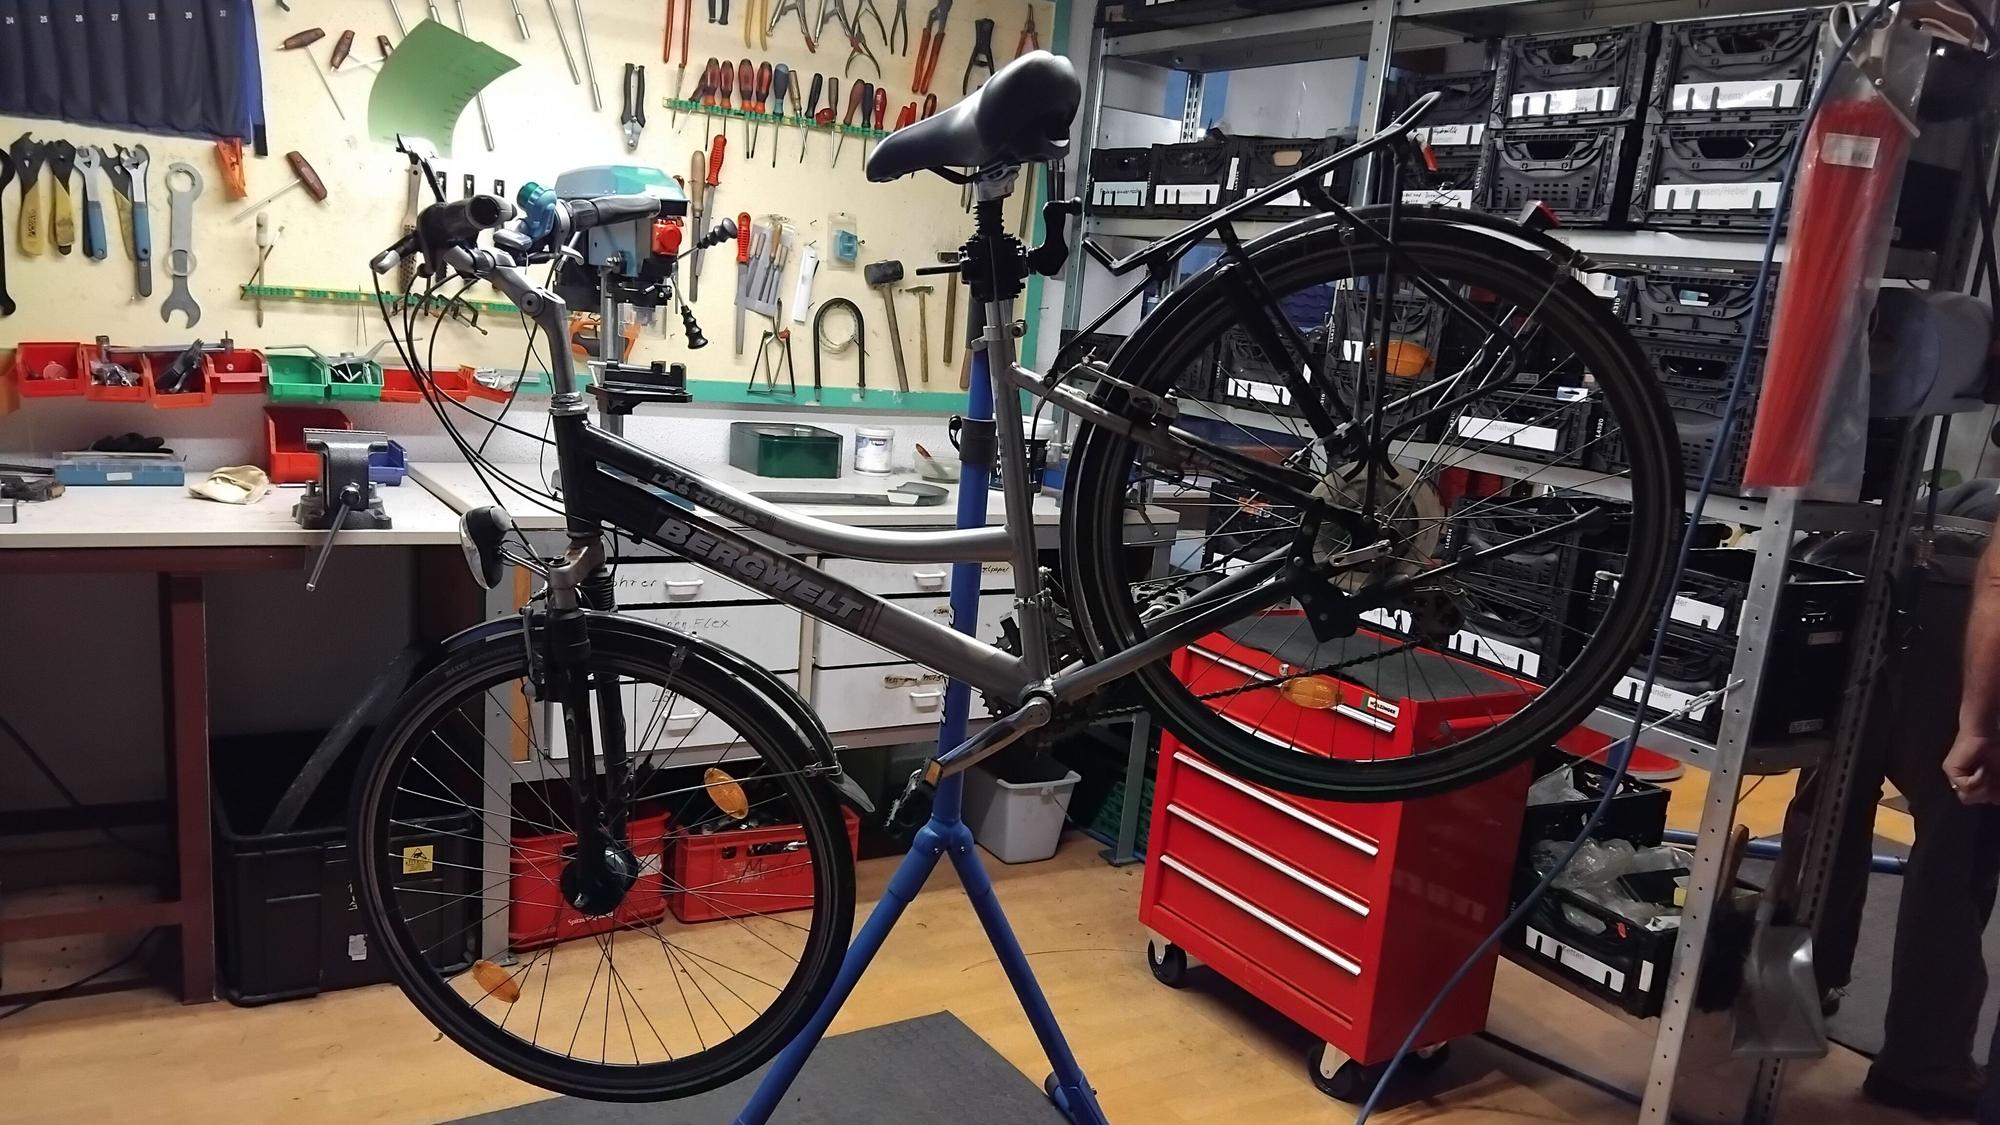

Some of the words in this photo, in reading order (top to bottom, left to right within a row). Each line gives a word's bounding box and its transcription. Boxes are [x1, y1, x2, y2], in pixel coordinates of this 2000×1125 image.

[6, 16, 14, 25] 24
[40, 15, 48, 23] 25
[111, 13, 119, 22] 27
[185, 12, 192, 20] 30
[651, 473, 690, 496] LAS
[695, 494, 758, 525] TUNAS
[656, 517, 864, 619] BERGWELT
